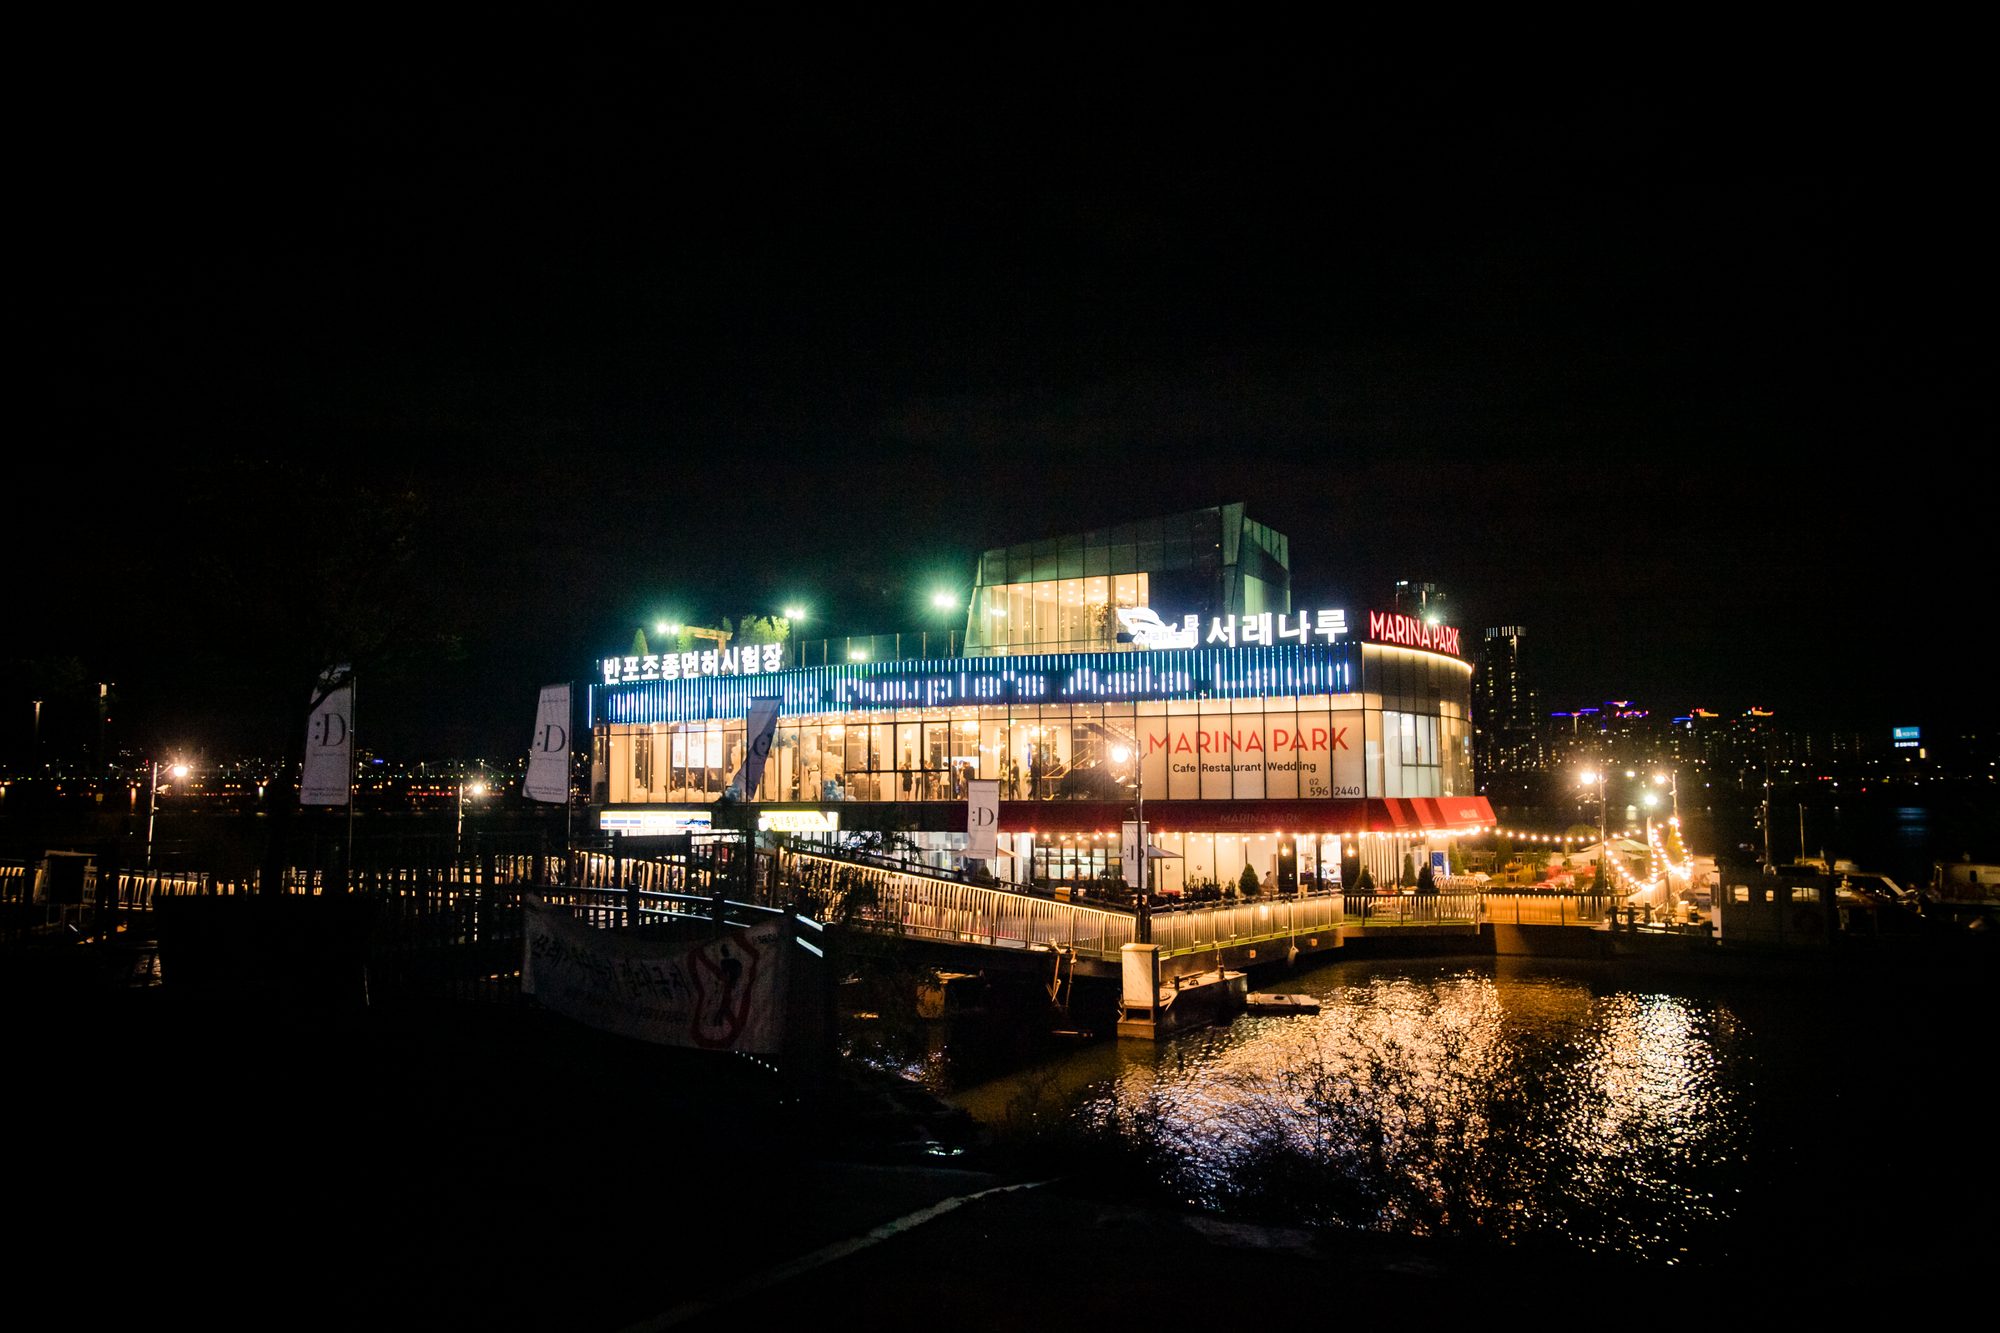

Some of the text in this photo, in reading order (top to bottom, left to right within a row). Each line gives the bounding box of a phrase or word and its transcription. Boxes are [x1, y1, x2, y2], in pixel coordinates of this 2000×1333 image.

[1207, 609, 1348, 647] 서래나루
[1369, 610, 1461, 656] MARINA PARK
[603, 643, 783, 685] 반포조종면허시험장
[1148, 727, 1350, 755] MARINA PARK
[1172, 761, 1317, 774] Cafe Restaurant Wedding
[1309, 785, 1361, 797] 596 2440
[1220, 813, 1267, 825] MARINA
